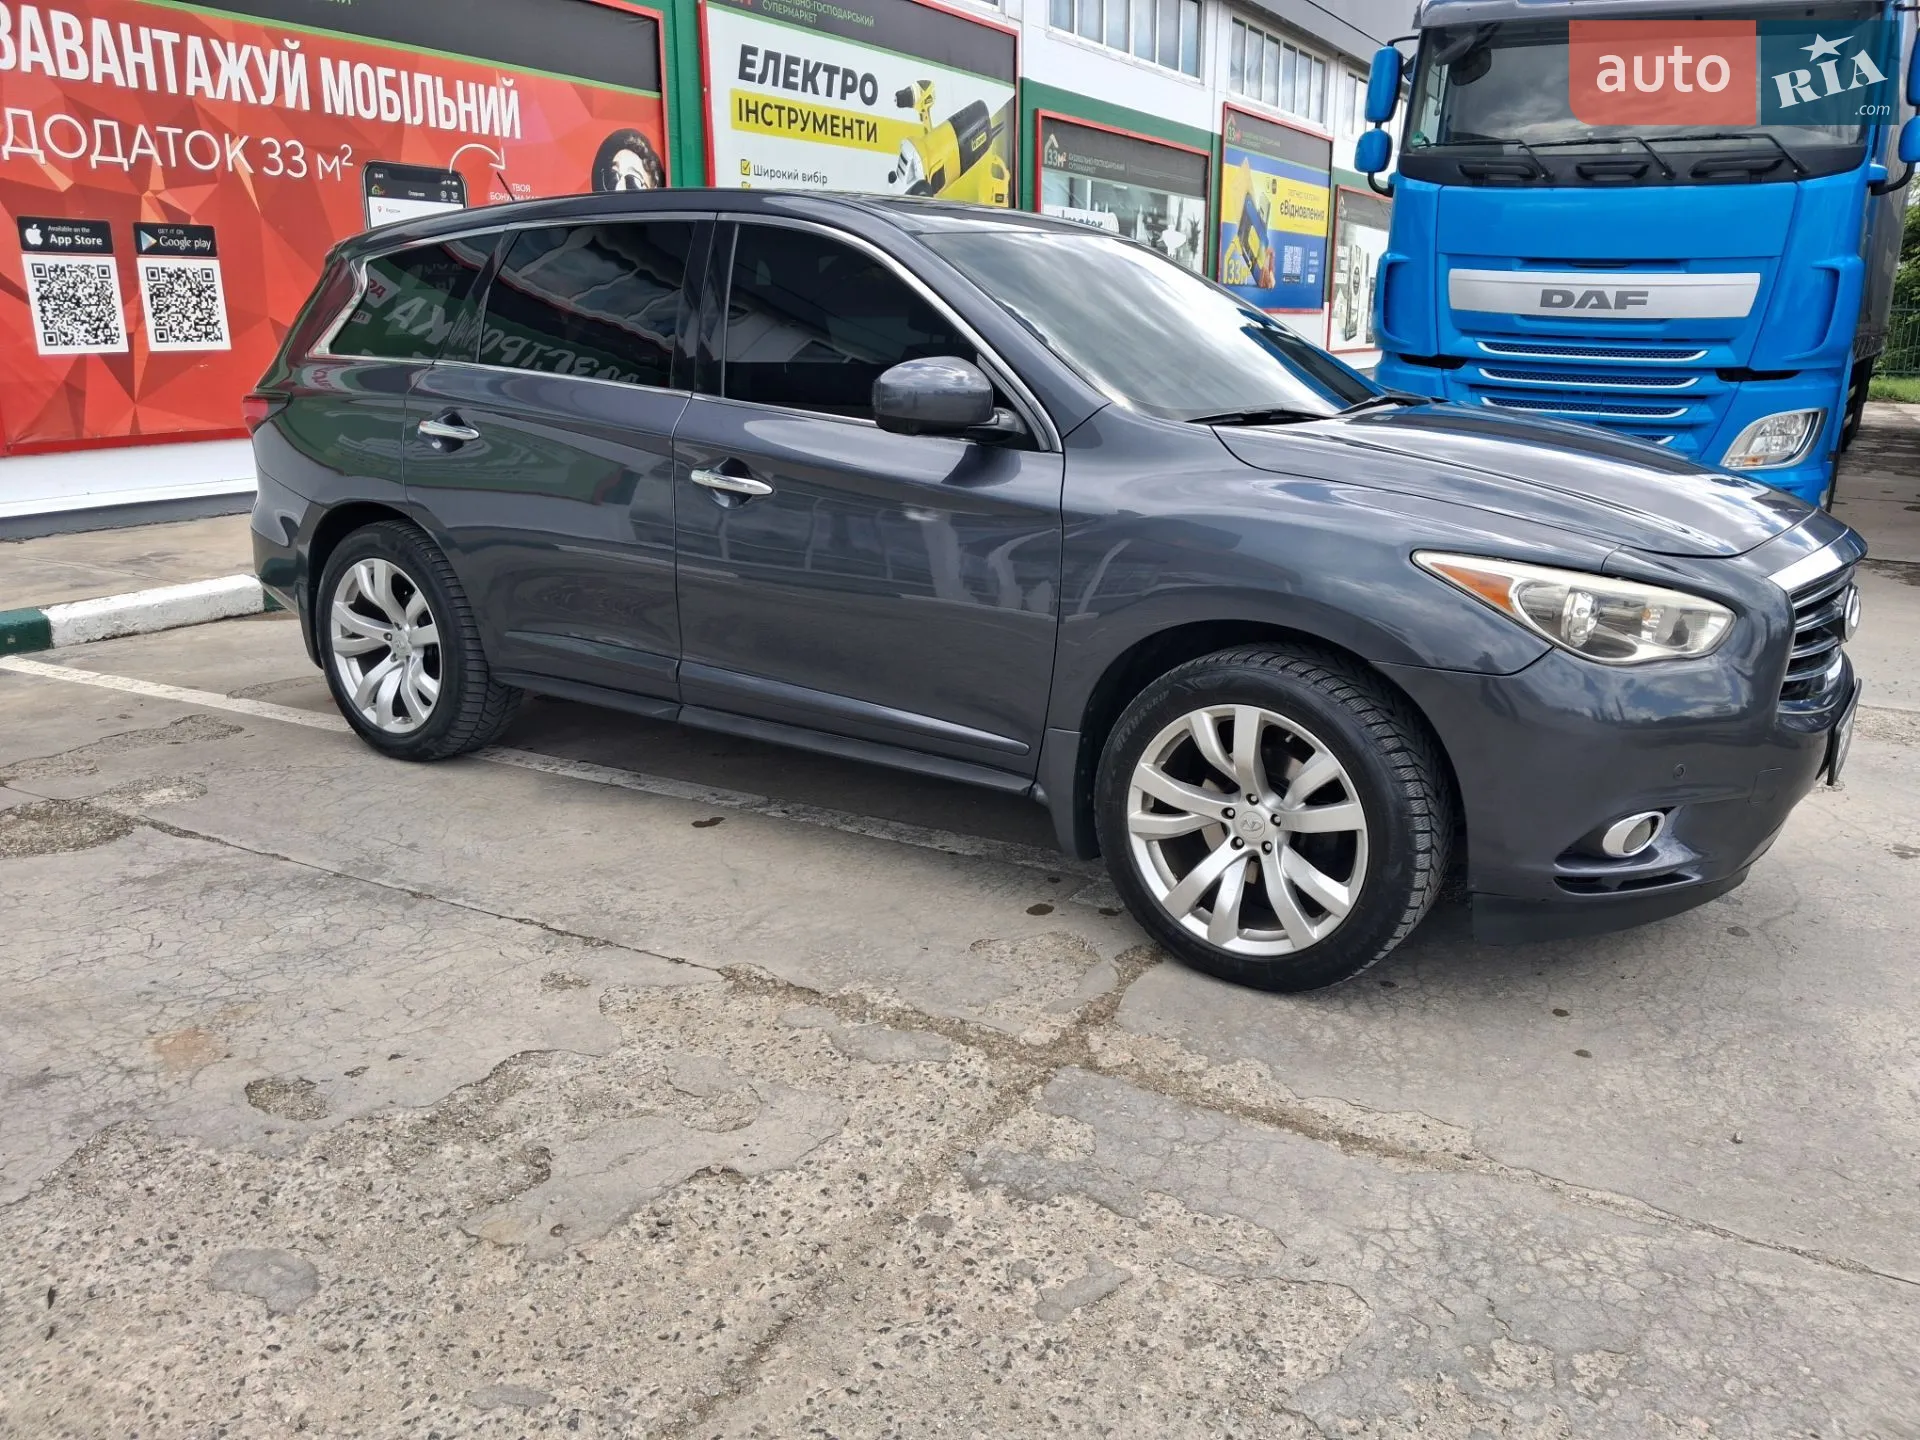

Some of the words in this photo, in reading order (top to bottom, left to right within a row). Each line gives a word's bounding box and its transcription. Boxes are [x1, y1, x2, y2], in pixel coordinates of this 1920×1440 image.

[762, 0, 817, 24] СУПЕРМАРКЕТ
[738, 43, 879, 106] ЕЛЕКТРО
[319, 56, 522, 140] МОБІЛЬНИЙ
[738, 97, 878, 143] ІНСТРУМЕНТИ
[1, 107, 254, 174] ДОДАТОК
[260, 136, 308, 179] 33
[753, 163, 799, 181] Широкий
[801, 170, 828, 186] вибір
[512, 183, 531, 193] ТВОЯ
[49, 233, 72, 246] App
[74, 234, 103, 245] Store
[159, 235, 191, 250] Google
[194, 237, 212, 252] play
[1540, 289, 1649, 310] DAF
